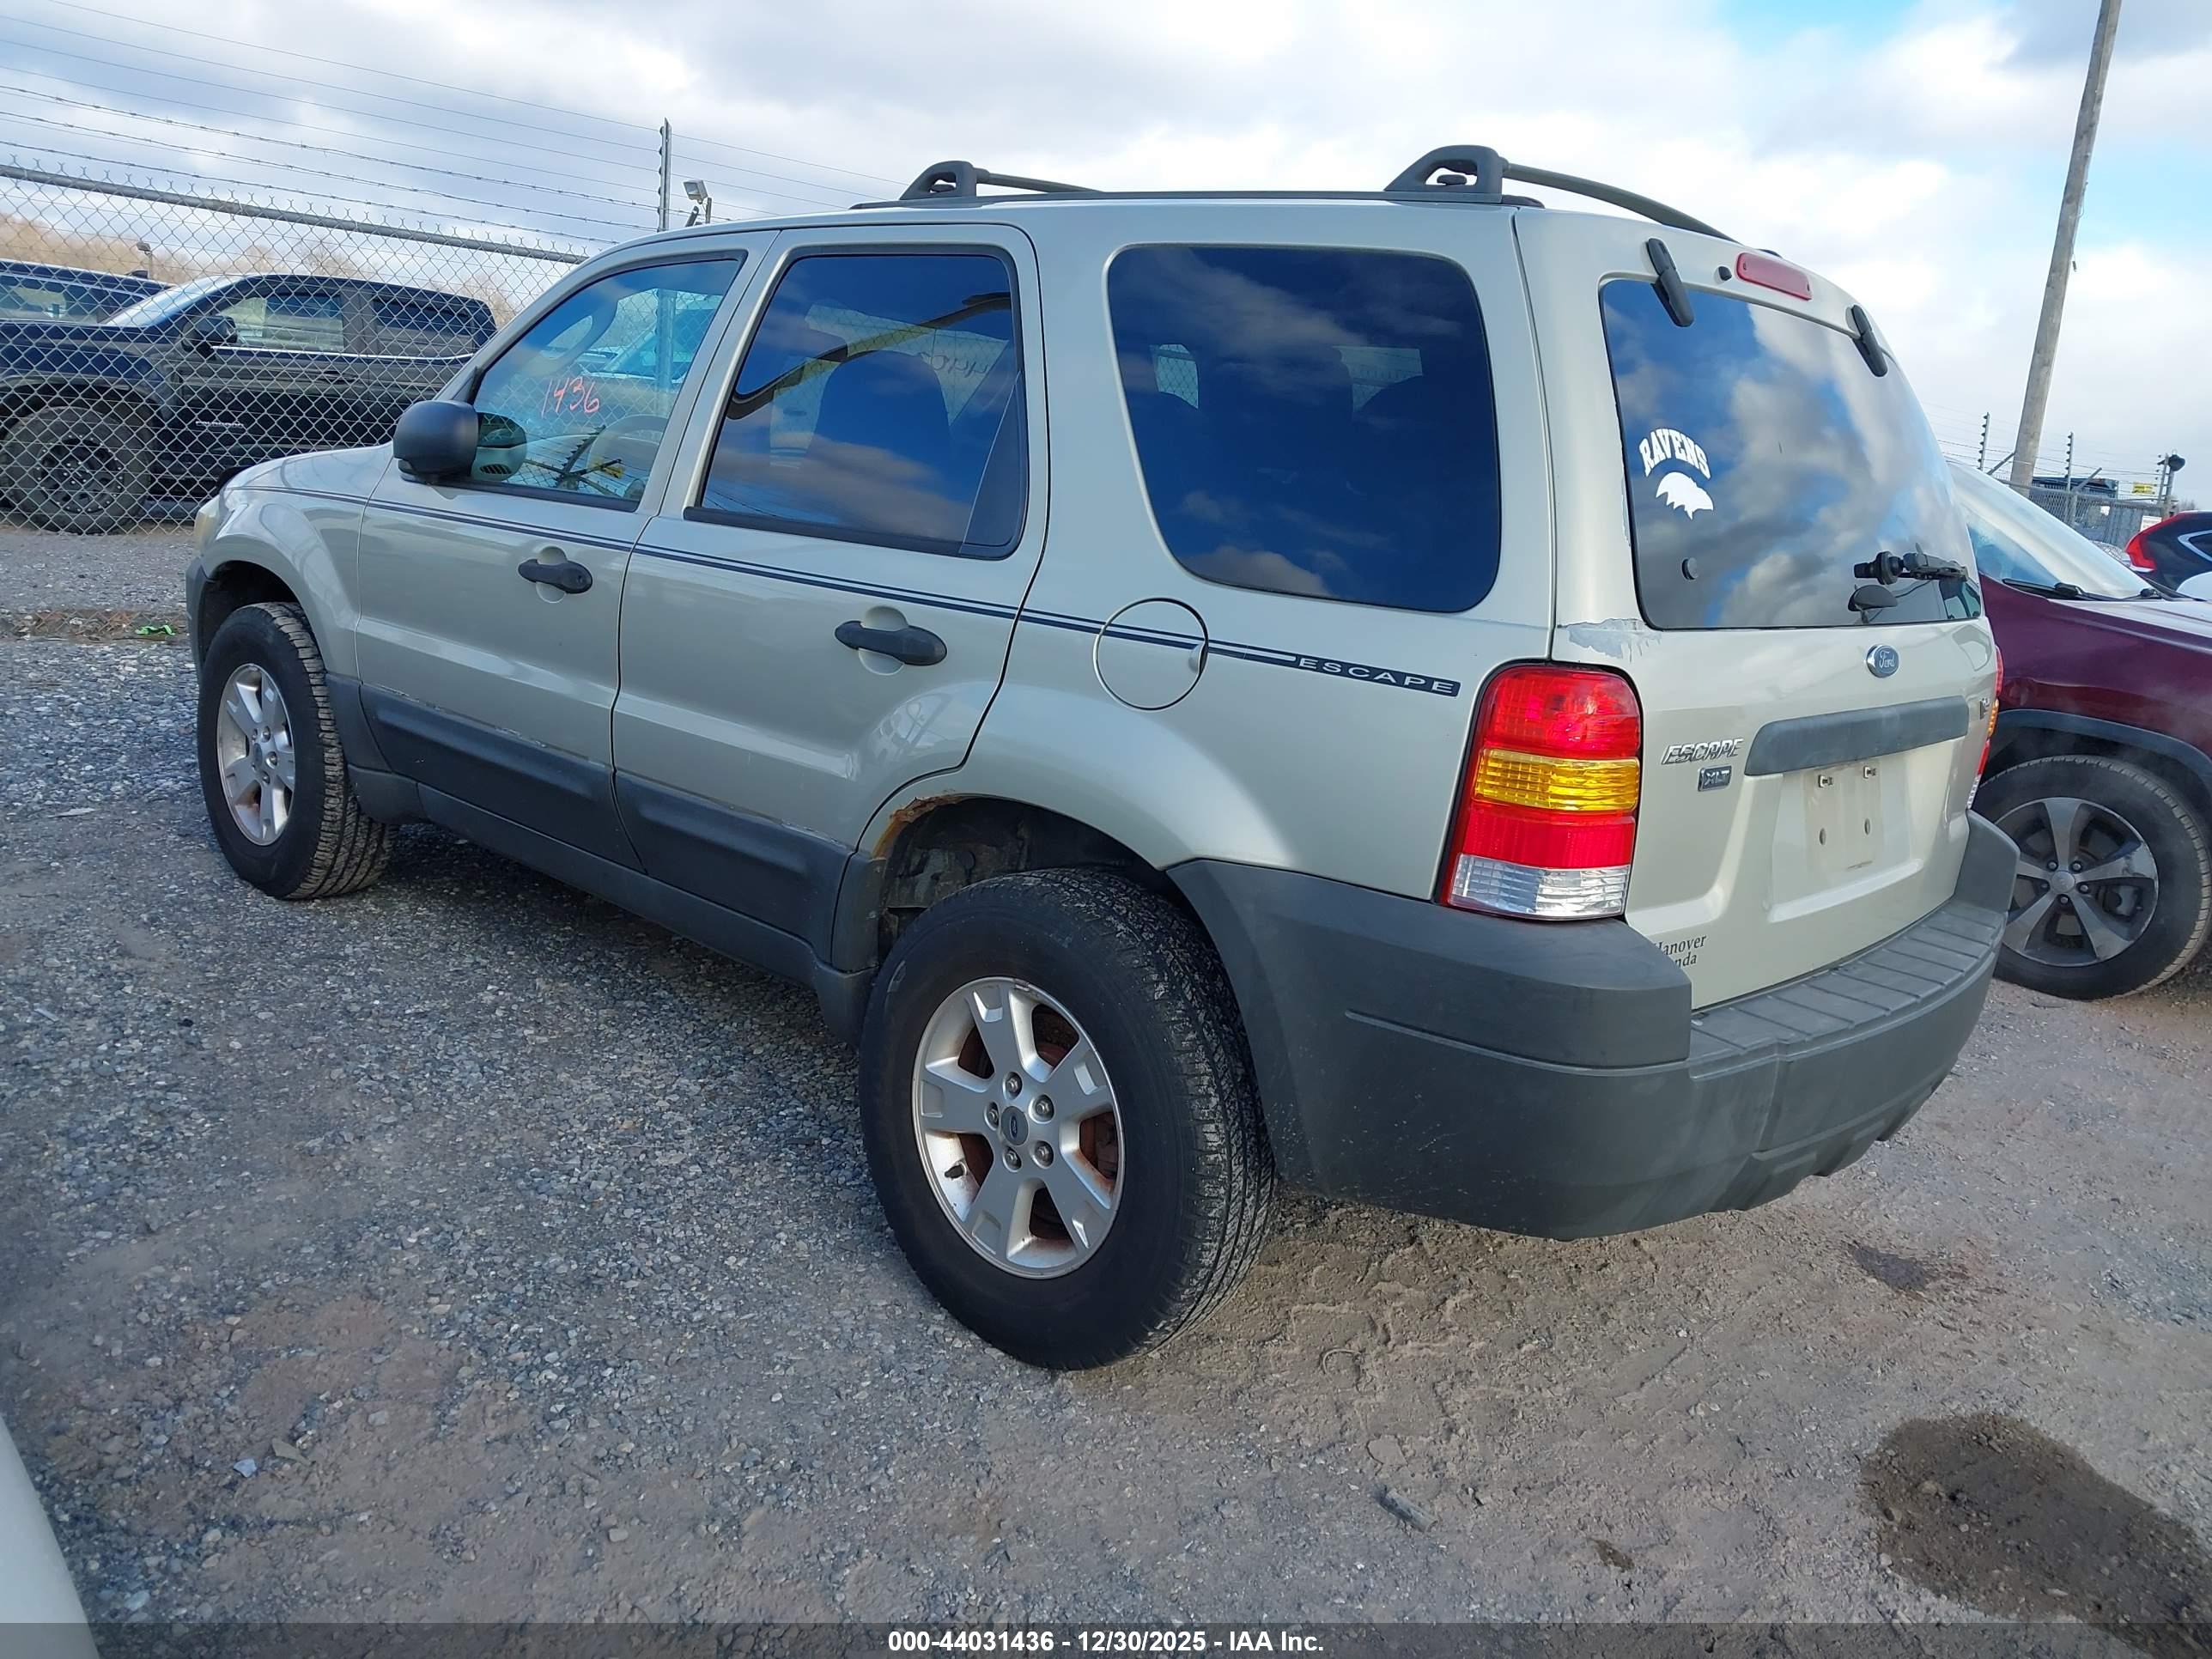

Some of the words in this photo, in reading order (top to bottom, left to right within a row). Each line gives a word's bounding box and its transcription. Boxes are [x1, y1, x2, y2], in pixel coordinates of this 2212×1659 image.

[541, 377, 599, 418] 1436
[1638, 428, 1711, 480] RAVENS
[1297, 657, 1455, 694] ESCAPE
[1661, 738, 1743, 765] ESCAPE
[1704, 769, 1730, 786] XLT
[1674, 951, 1698, 968] nda
